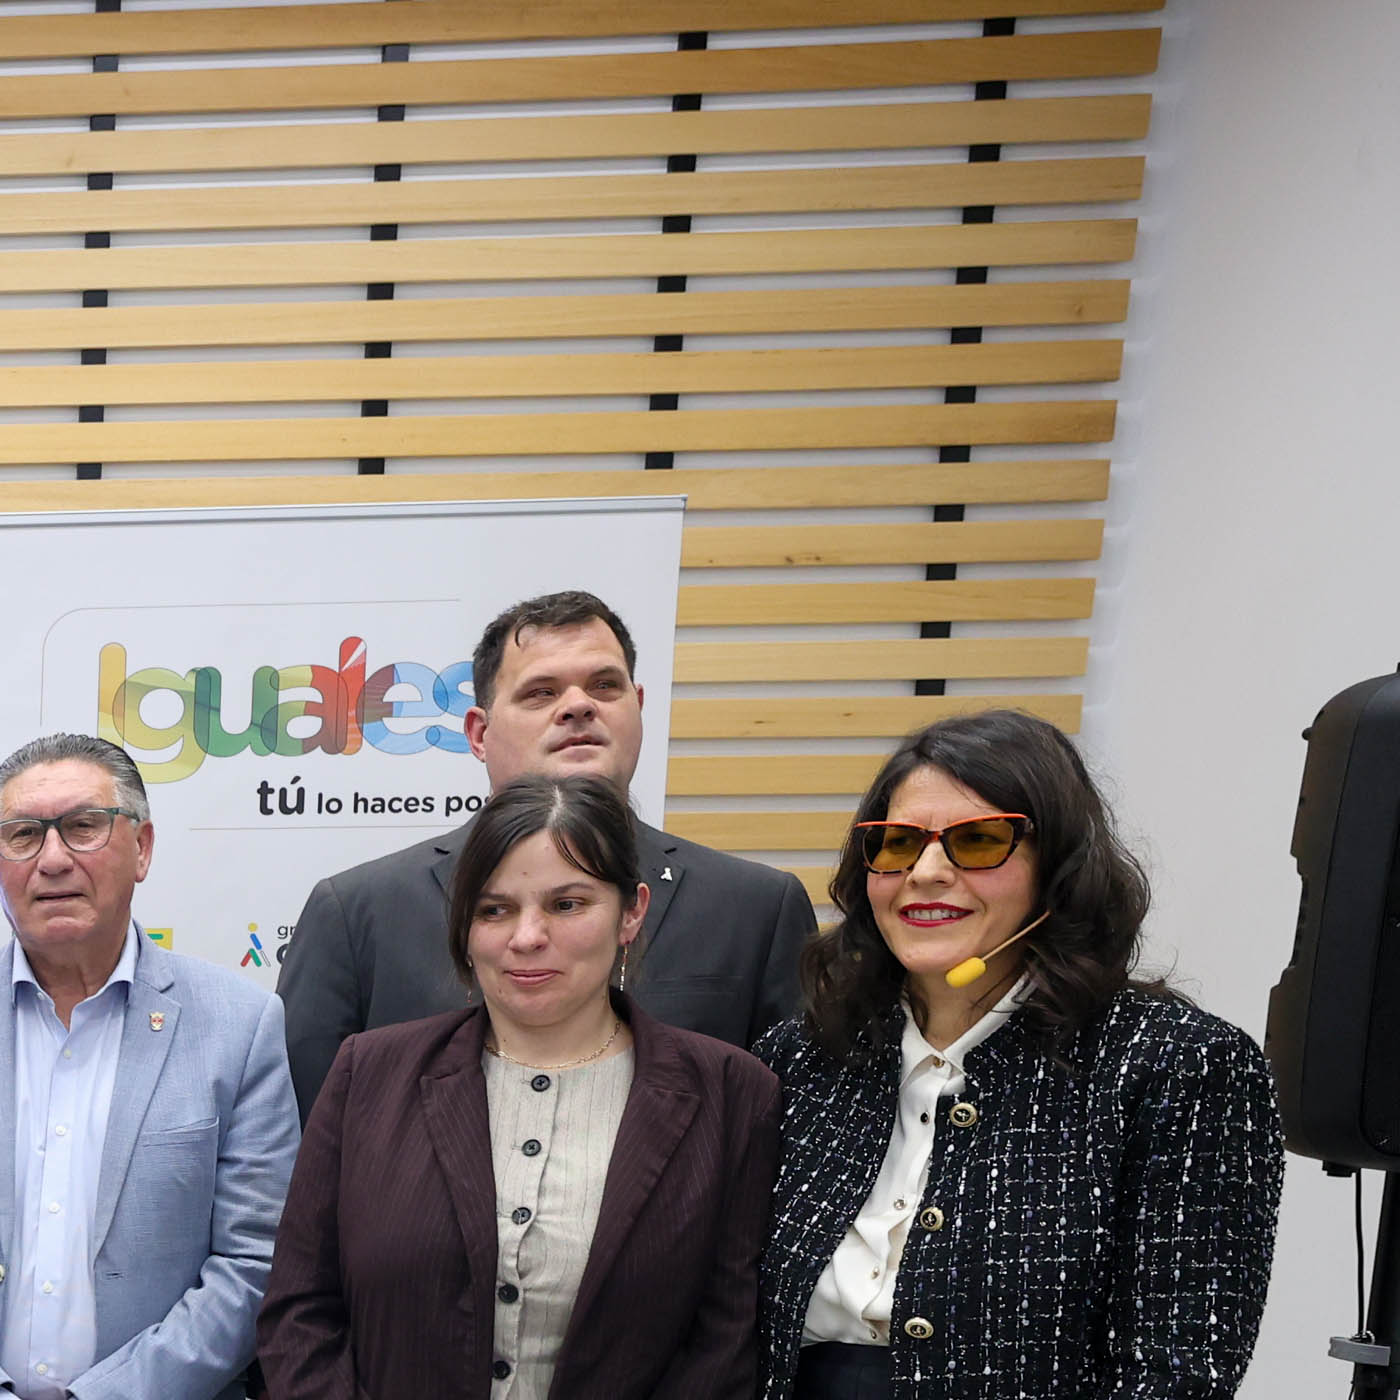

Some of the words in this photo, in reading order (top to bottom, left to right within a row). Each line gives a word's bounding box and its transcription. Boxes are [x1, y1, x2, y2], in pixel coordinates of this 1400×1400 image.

[256, 776, 305, 816] tú
[317, 792, 344, 815] lo
[352, 791, 435, 815] haces
